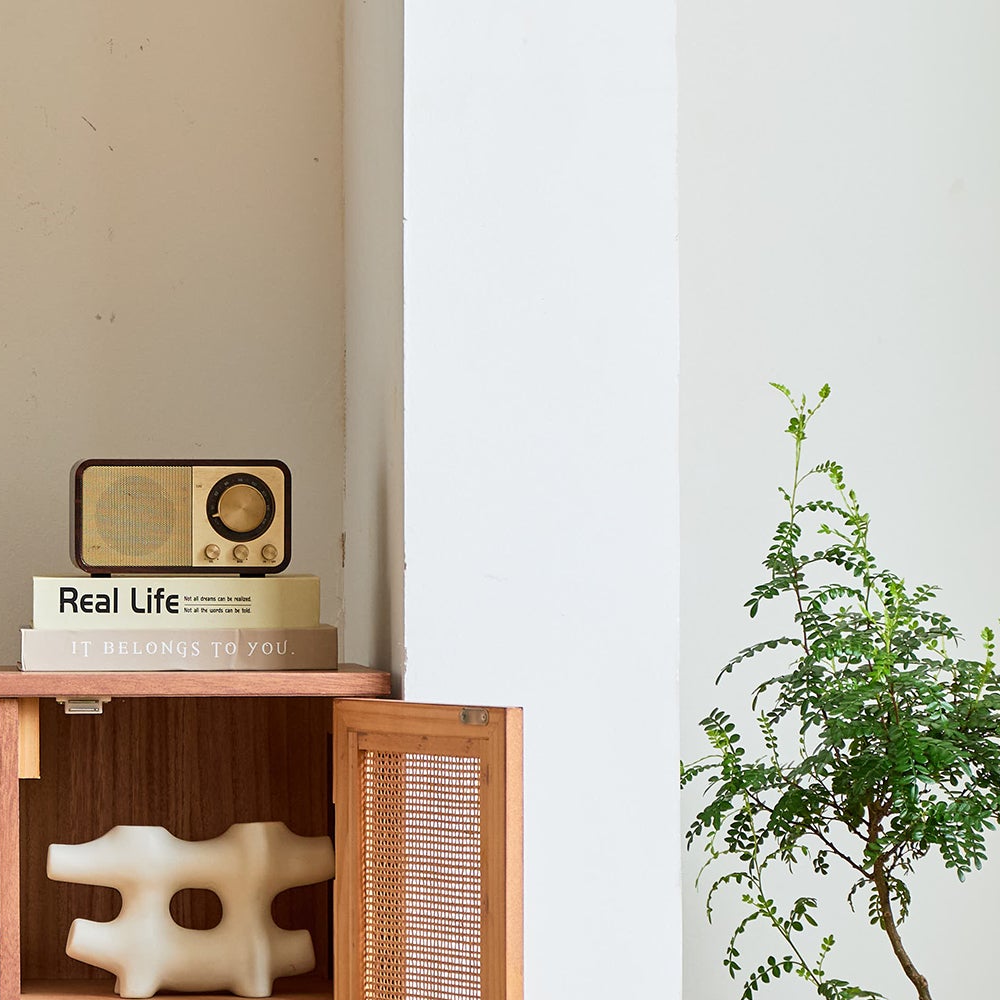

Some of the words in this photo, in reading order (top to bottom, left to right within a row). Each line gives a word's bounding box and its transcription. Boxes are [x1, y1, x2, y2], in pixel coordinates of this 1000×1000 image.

[59, 587, 119, 613] Real
[131, 587, 179, 613] Life
[71, 641, 91, 657] IT
[104, 640, 200, 658] BELONGS
[211, 641, 237, 657] TO
[247, 640, 295, 657] YOU.
